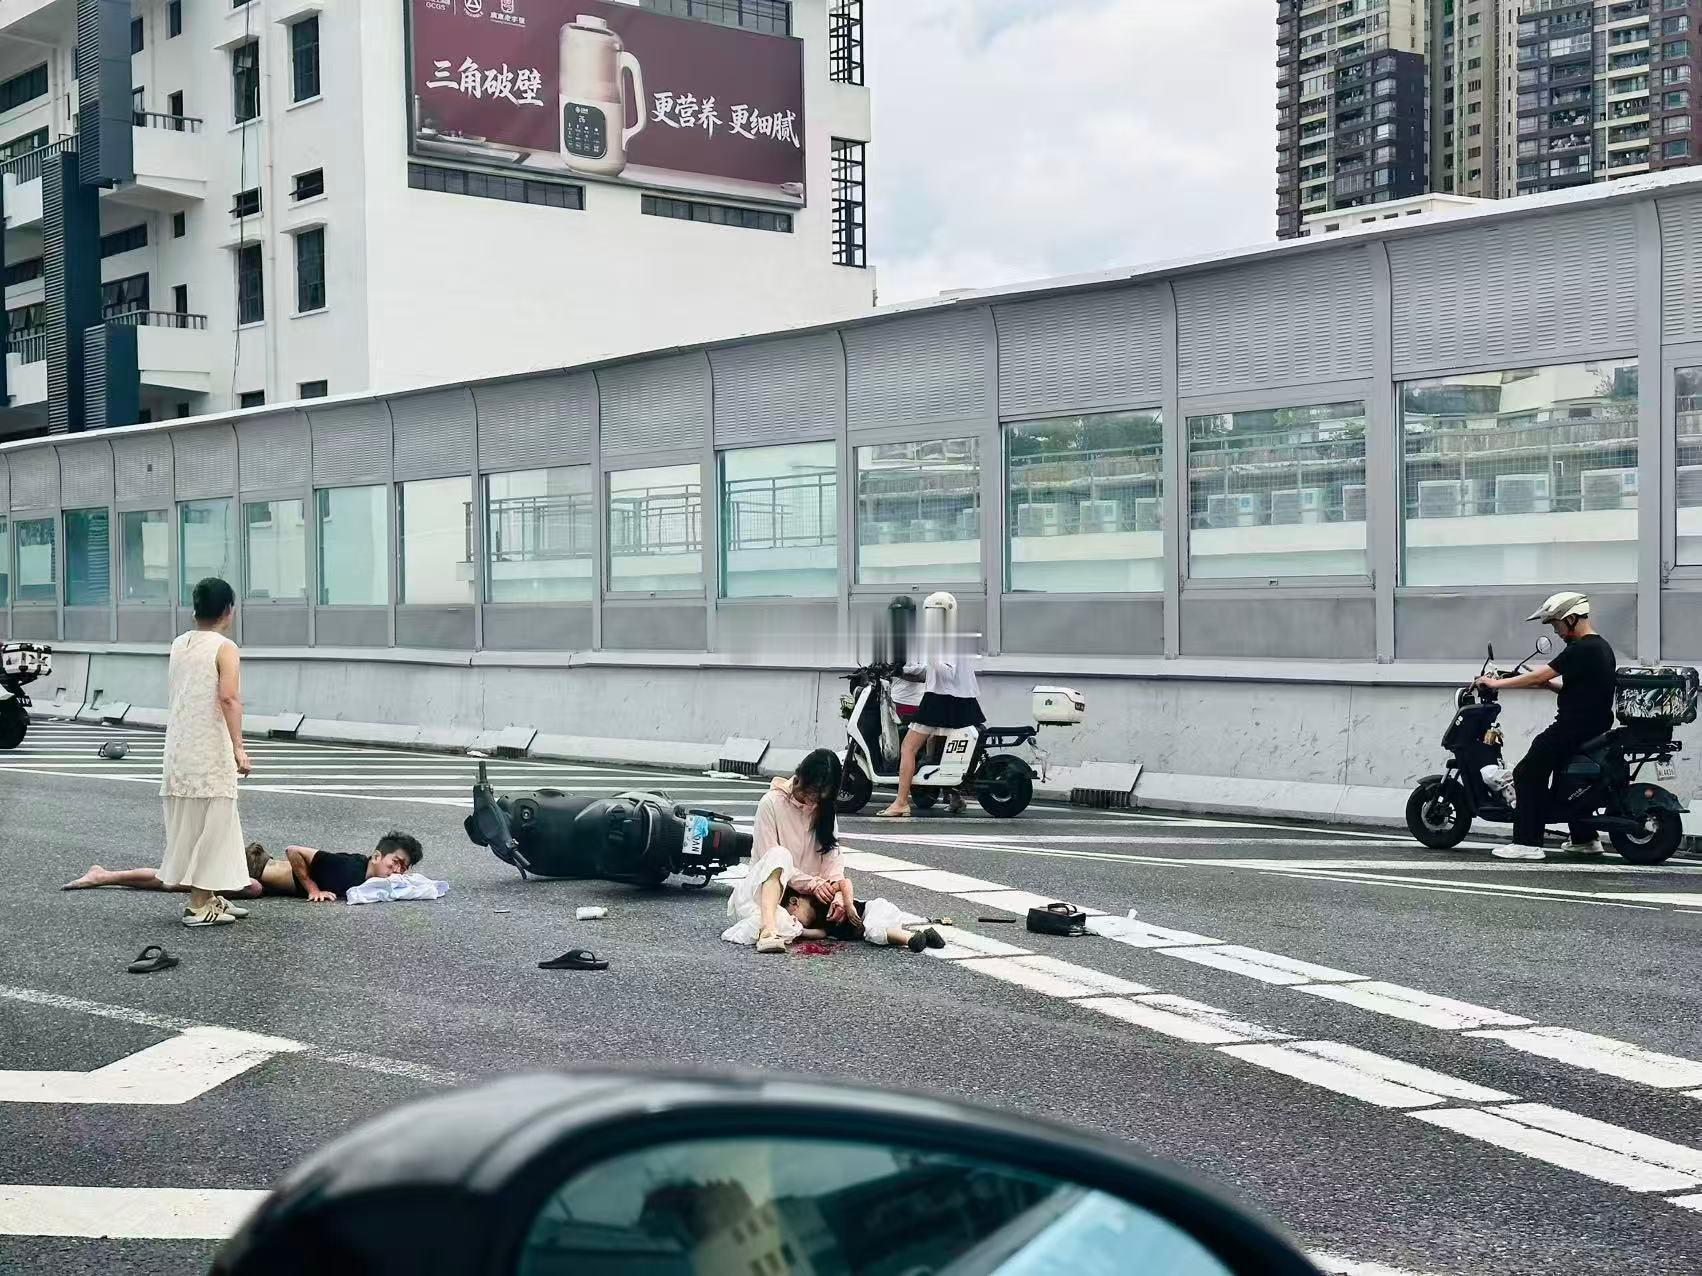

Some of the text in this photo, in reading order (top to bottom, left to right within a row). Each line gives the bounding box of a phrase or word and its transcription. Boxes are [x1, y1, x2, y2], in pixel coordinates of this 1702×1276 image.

[426, 2, 446, 11] GCGS
[425, 56, 544, 107] 三角破壁
[650, 91, 723, 140] 更营养
[728, 104, 800, 149] 更细腻
